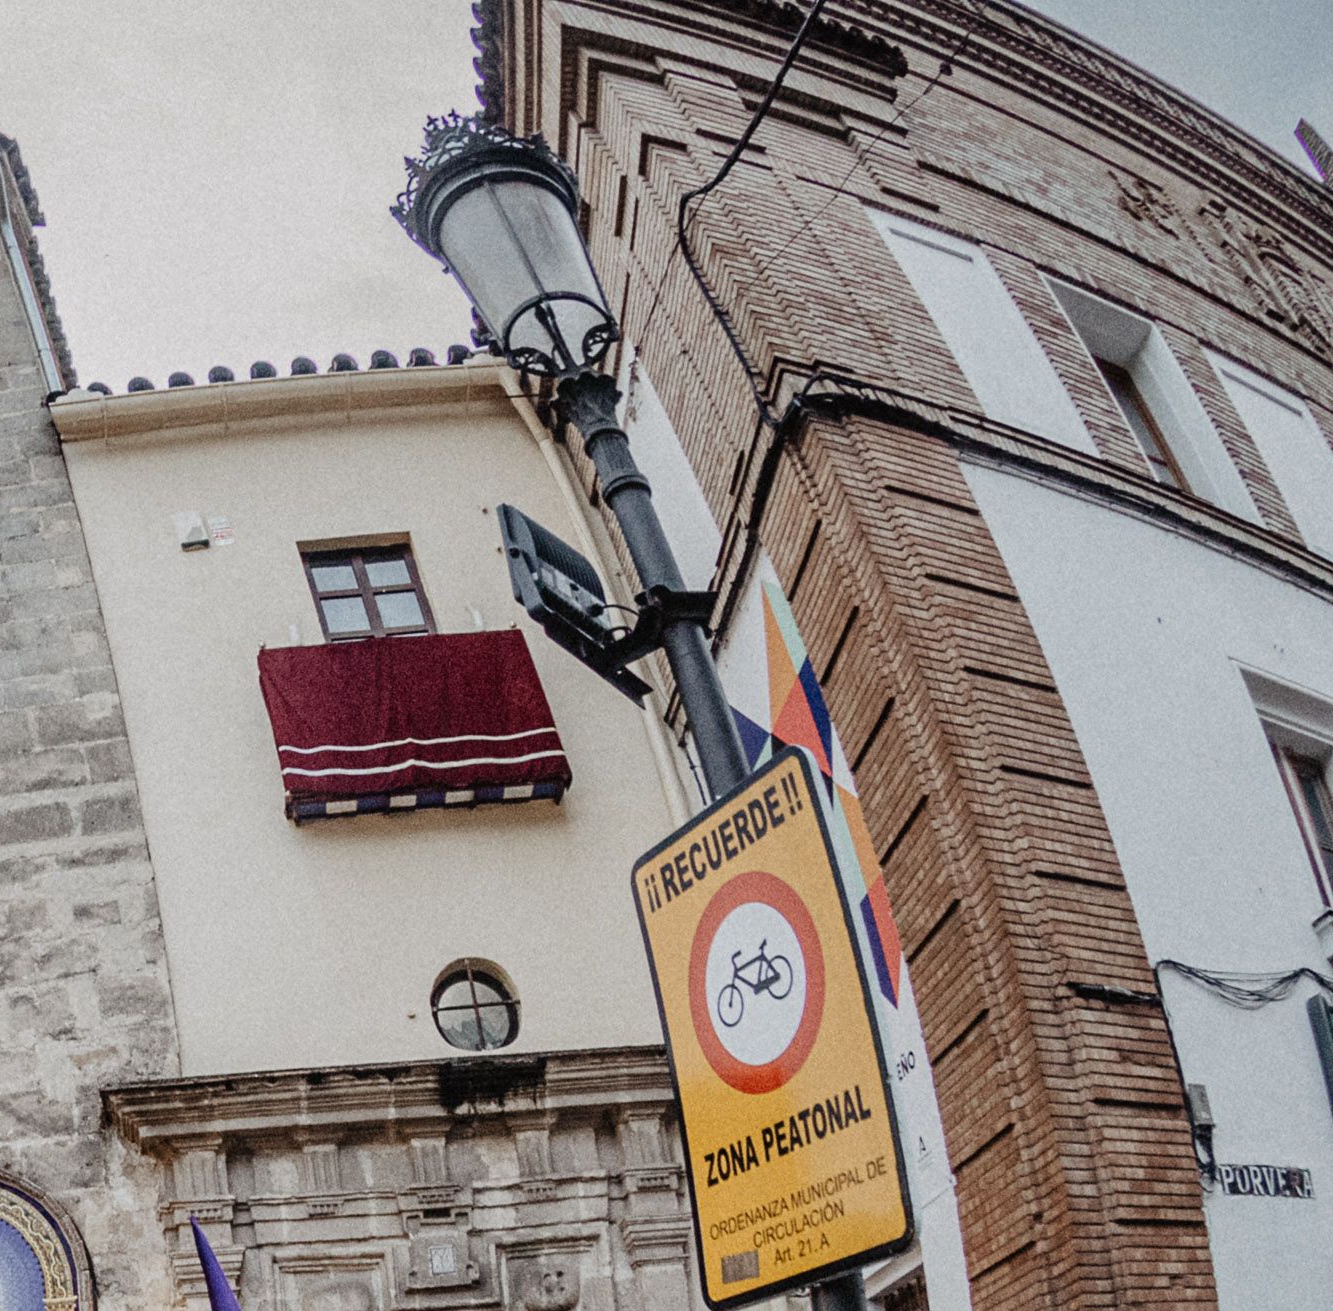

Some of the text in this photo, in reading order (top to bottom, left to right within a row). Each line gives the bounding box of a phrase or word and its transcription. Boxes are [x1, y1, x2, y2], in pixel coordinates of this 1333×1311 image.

[704, 1085, 872, 1187] ZONA PEATONAL
[709, 1156, 888, 1241] ORDENANZA MUNICIPAL DE
[753, 1200, 845, 1249] CIRCULACIÓN
[773, 1246, 795, 1266] Art.
[820, 1233, 830, 1248] A
